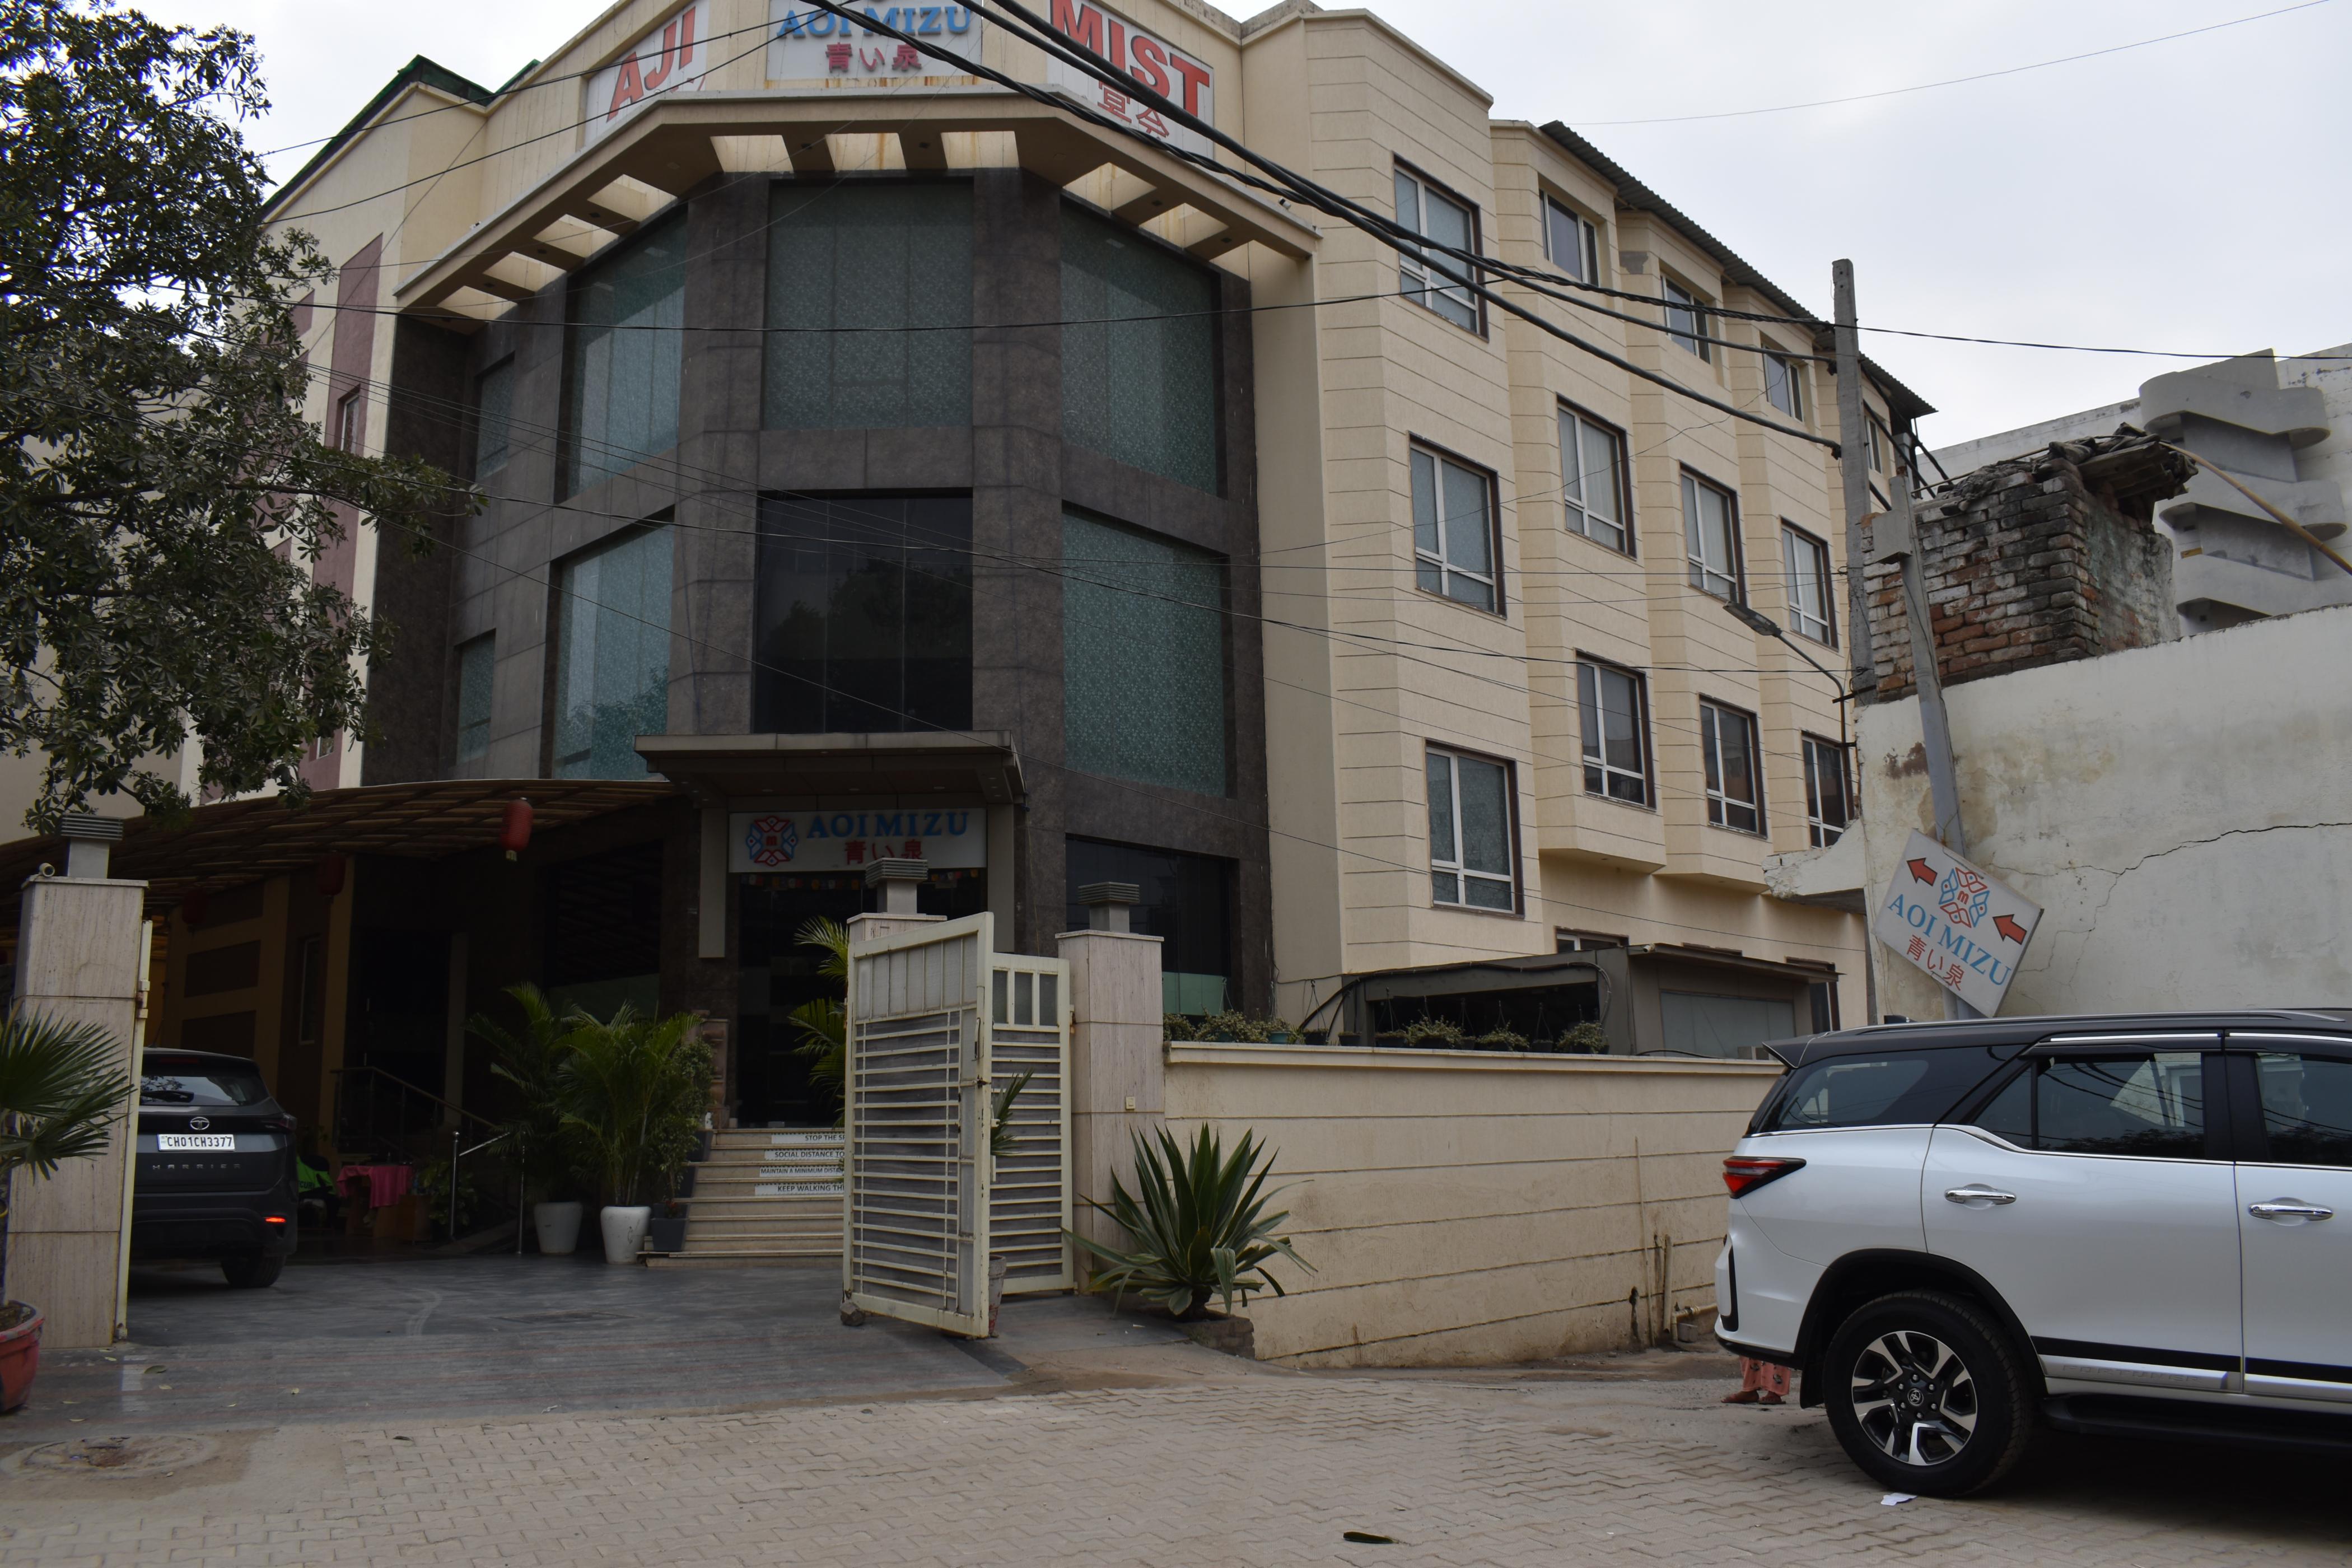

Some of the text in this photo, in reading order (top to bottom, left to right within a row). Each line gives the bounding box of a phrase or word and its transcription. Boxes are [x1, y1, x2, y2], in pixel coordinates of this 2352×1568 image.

[777, 6, 972, 38] AOI MIZU
[606, 6, 696, 123] AJI
[825, 42, 922, 72] 青い泉
[1051, 0, 1210, 118] MIST
[807, 811, 969, 839] AOI MIZU
[1887, 894, 2012, 986] AOI MIZU
[1906, 934, 1964, 991] 青い泉
[167, 1137, 232, 1147] CH01CH3377
